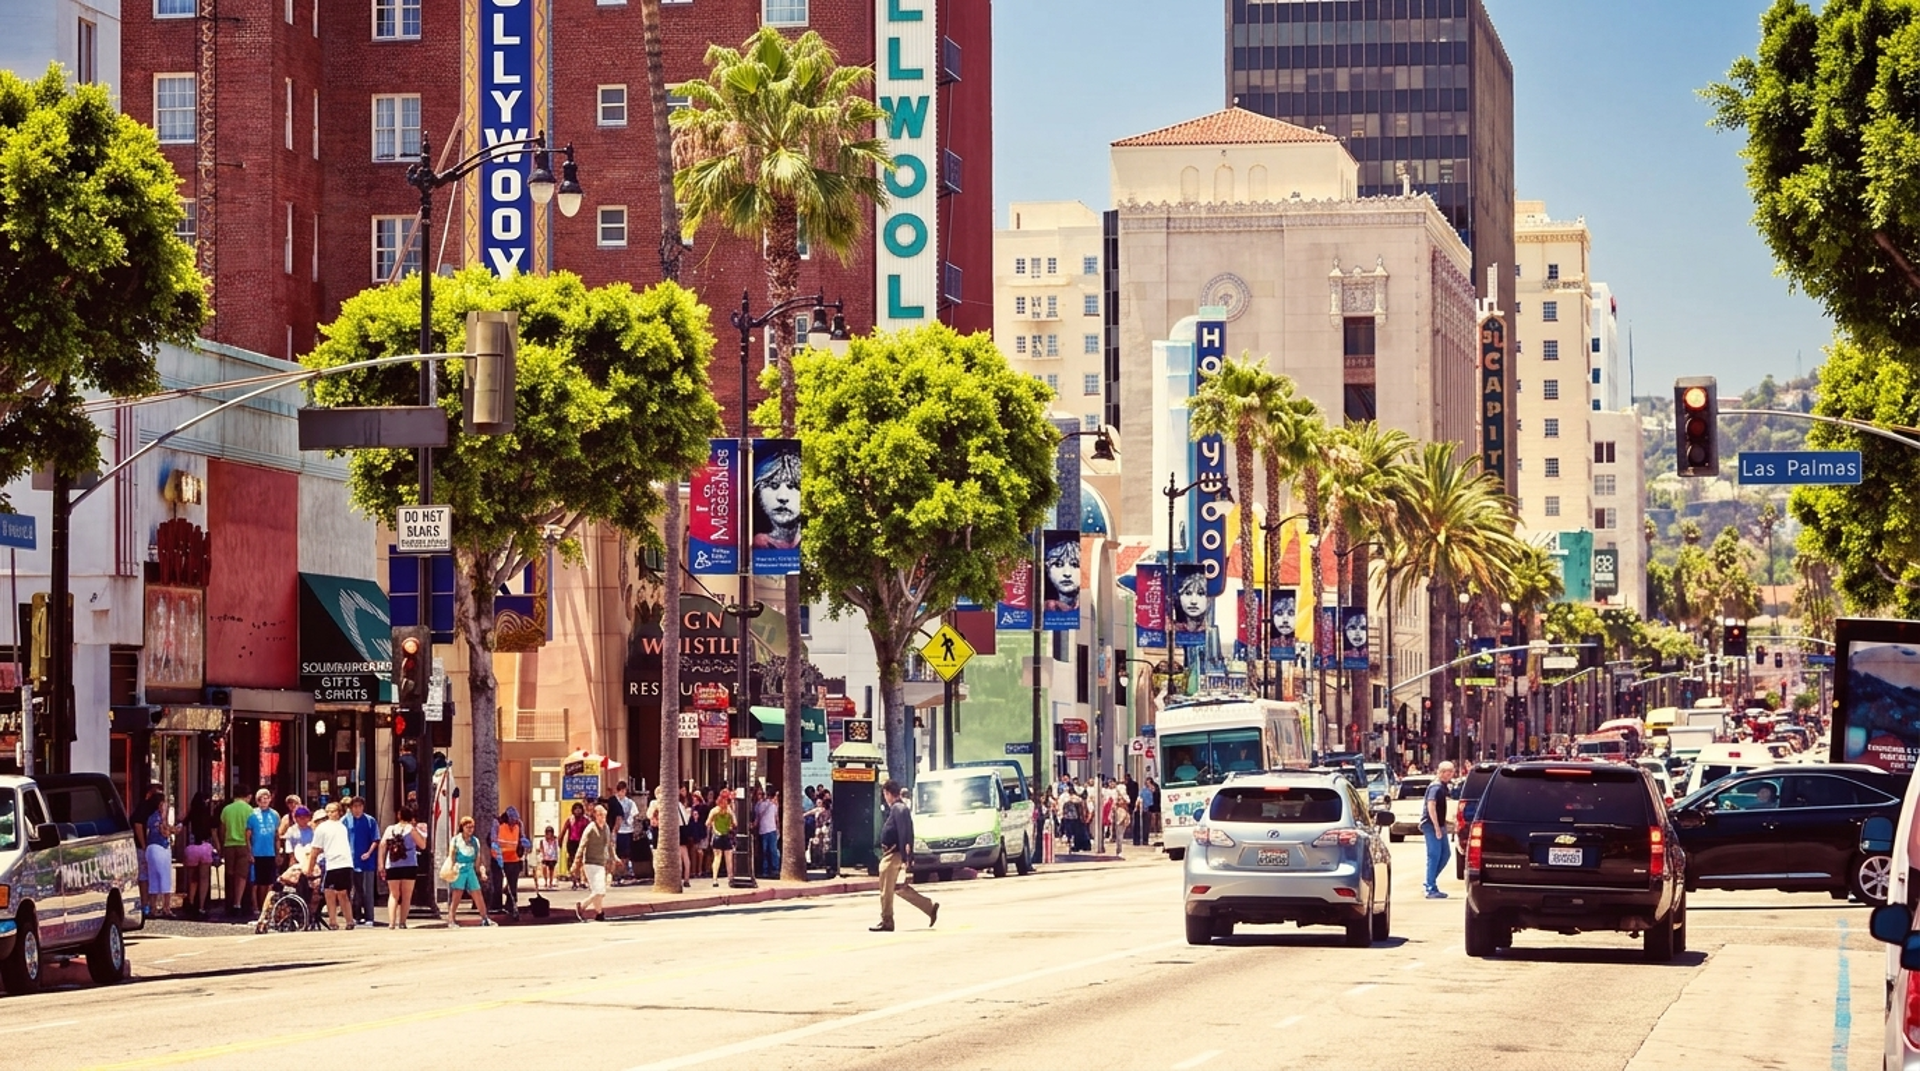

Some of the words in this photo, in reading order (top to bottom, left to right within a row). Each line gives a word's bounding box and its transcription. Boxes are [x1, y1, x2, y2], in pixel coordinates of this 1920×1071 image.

[1743, 460, 1775, 476] Las
[1788, 459, 1856, 476] Palmas
[405, 511, 418, 523] DO
